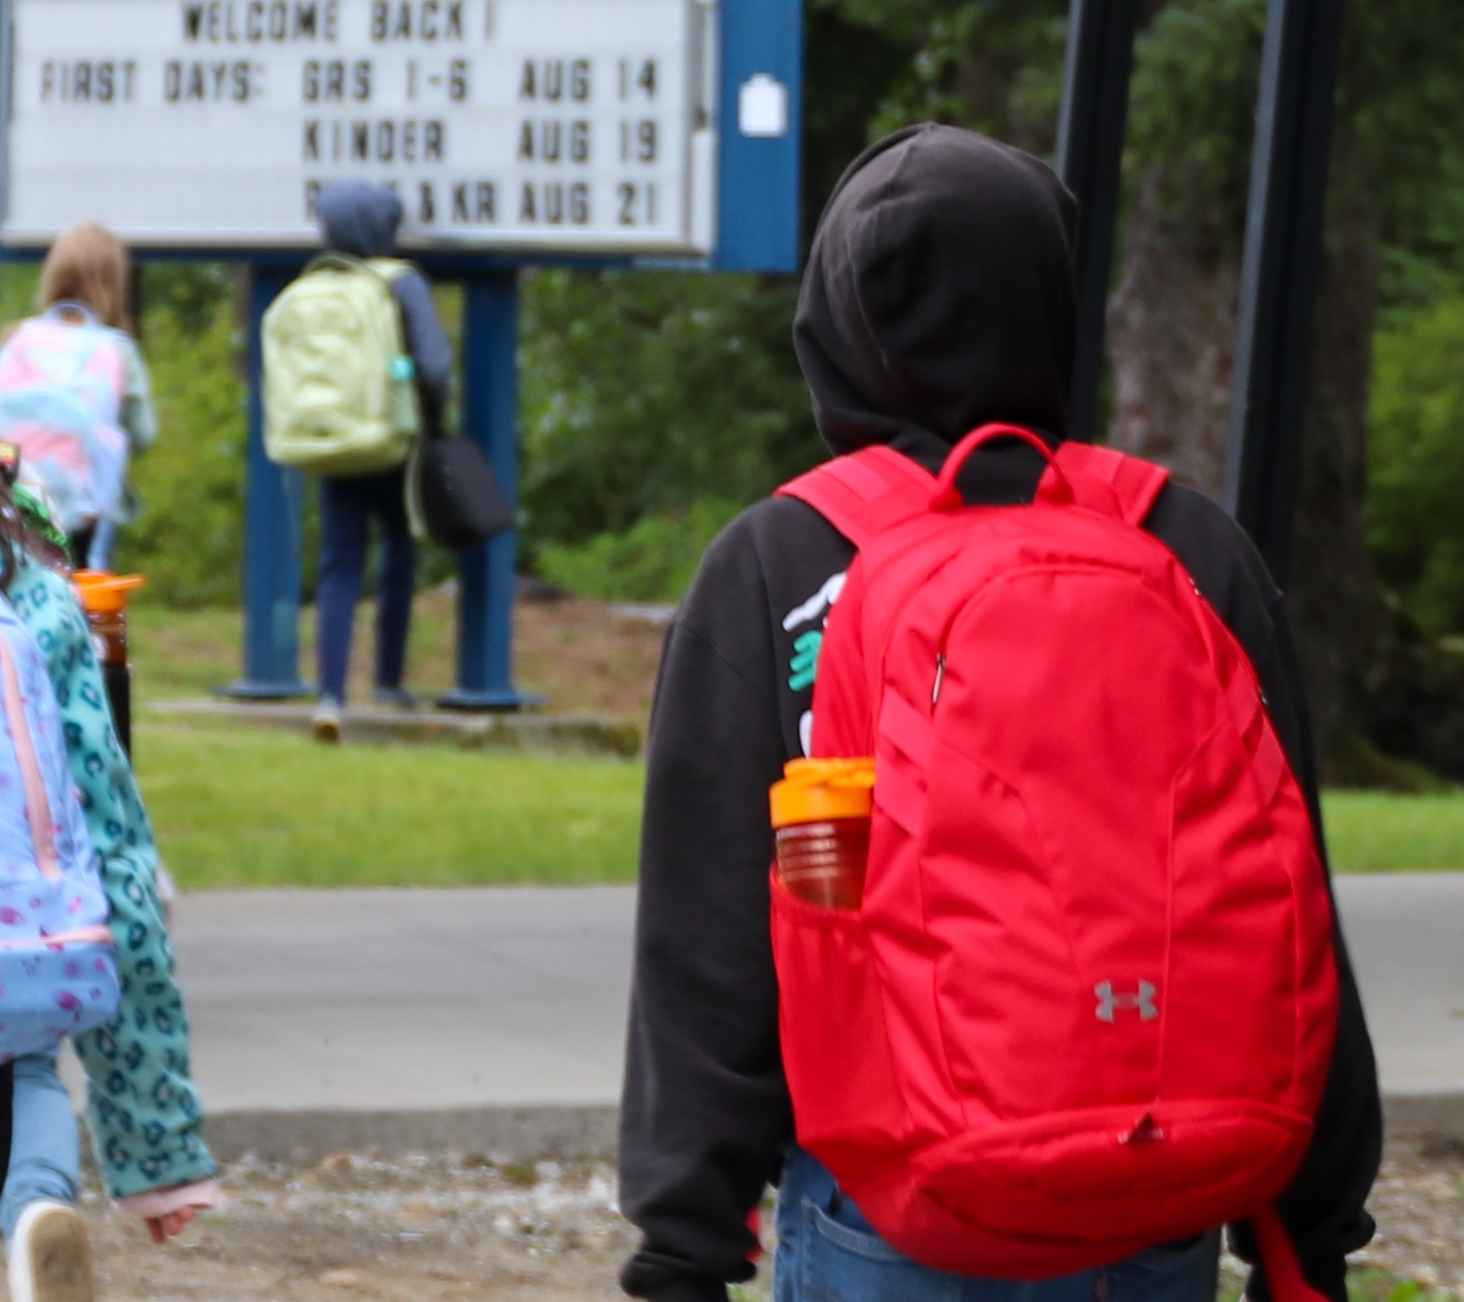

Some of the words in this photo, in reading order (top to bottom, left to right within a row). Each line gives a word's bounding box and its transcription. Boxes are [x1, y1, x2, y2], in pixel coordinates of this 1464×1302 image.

[182, 0, 339, 43] WELCOME
[41, 60, 137, 102] FIRST
[166, 60, 264, 102] DAYS:
[303, 59, 373, 103] GRS
[407, 59, 468, 102] 1-6
[520, 58, 592, 102] AUG
[619, 58, 657, 101] 14
[303, 119, 445, 162] KINDER
[520, 119, 593, 163] AUG
[619, 119, 657, 163] 19
[452, 181, 497, 223] KR
[521, 181, 593, 224] AUG
[617, 181, 657, 225] 21
